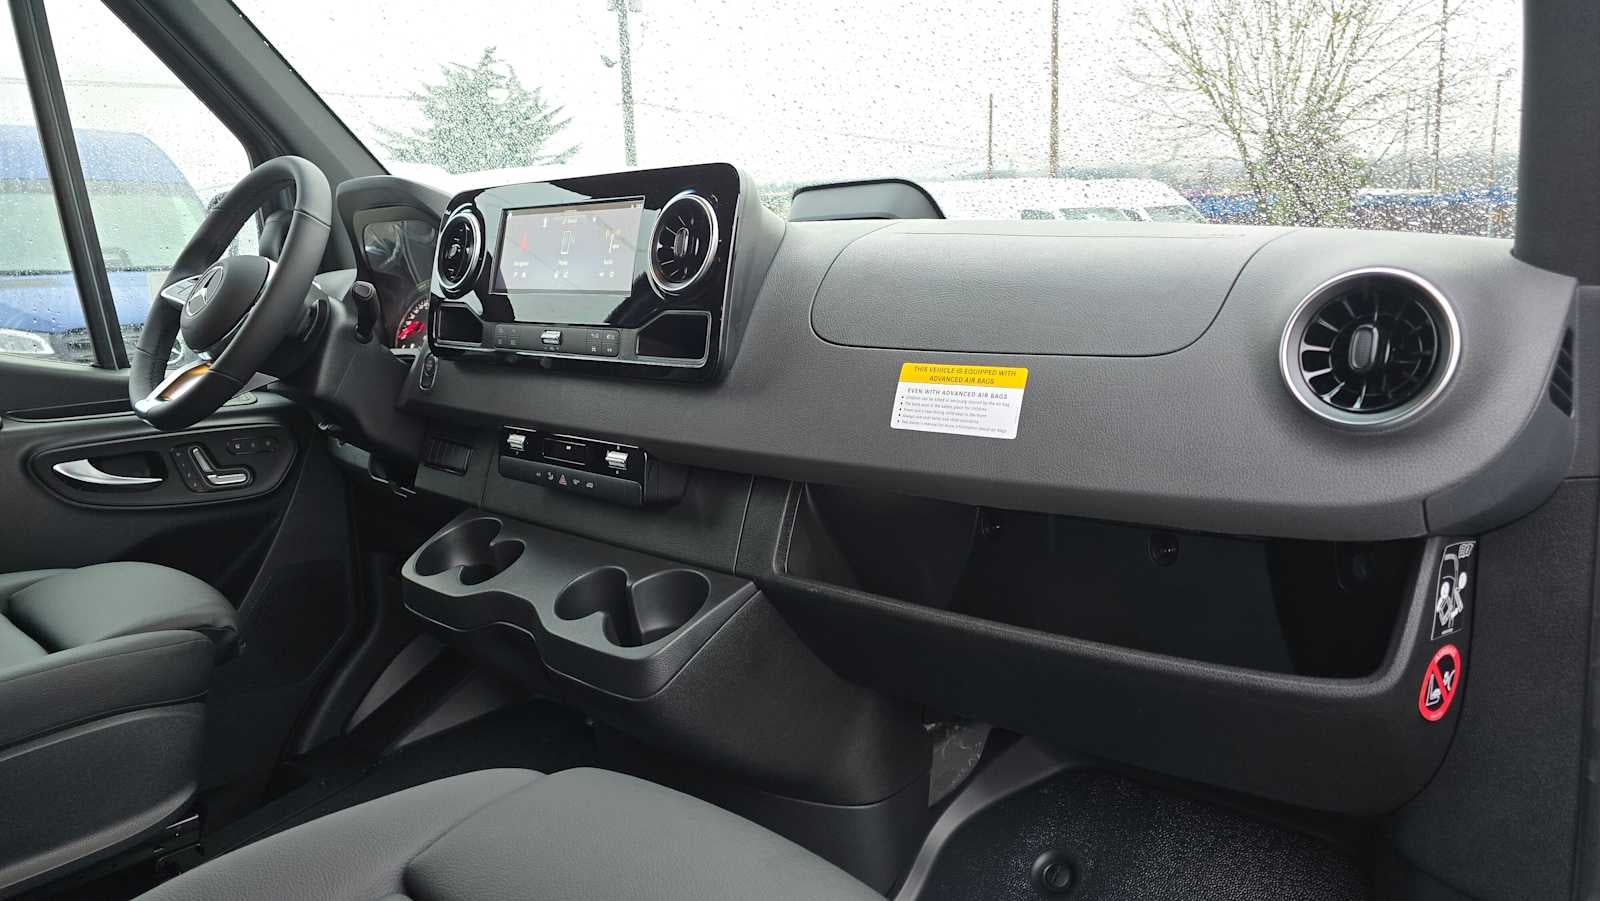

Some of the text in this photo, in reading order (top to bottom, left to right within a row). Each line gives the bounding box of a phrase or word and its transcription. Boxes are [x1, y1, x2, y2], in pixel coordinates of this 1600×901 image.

[914, 365, 928, 373] THIS
[929, 366, 955, 374] VEHICLE
[964, 367, 997, 376] EQUIPPED
[998, 368, 1017, 377] WITH
[929, 375, 995, 385] ADVANCED AIR BAGS
[924, 388, 941, 396] WITH
[941, 389, 976, 398] ADVANCED
[977, 391, 989, 399] AIR
[990, 392, 1008, 400] BAGS
